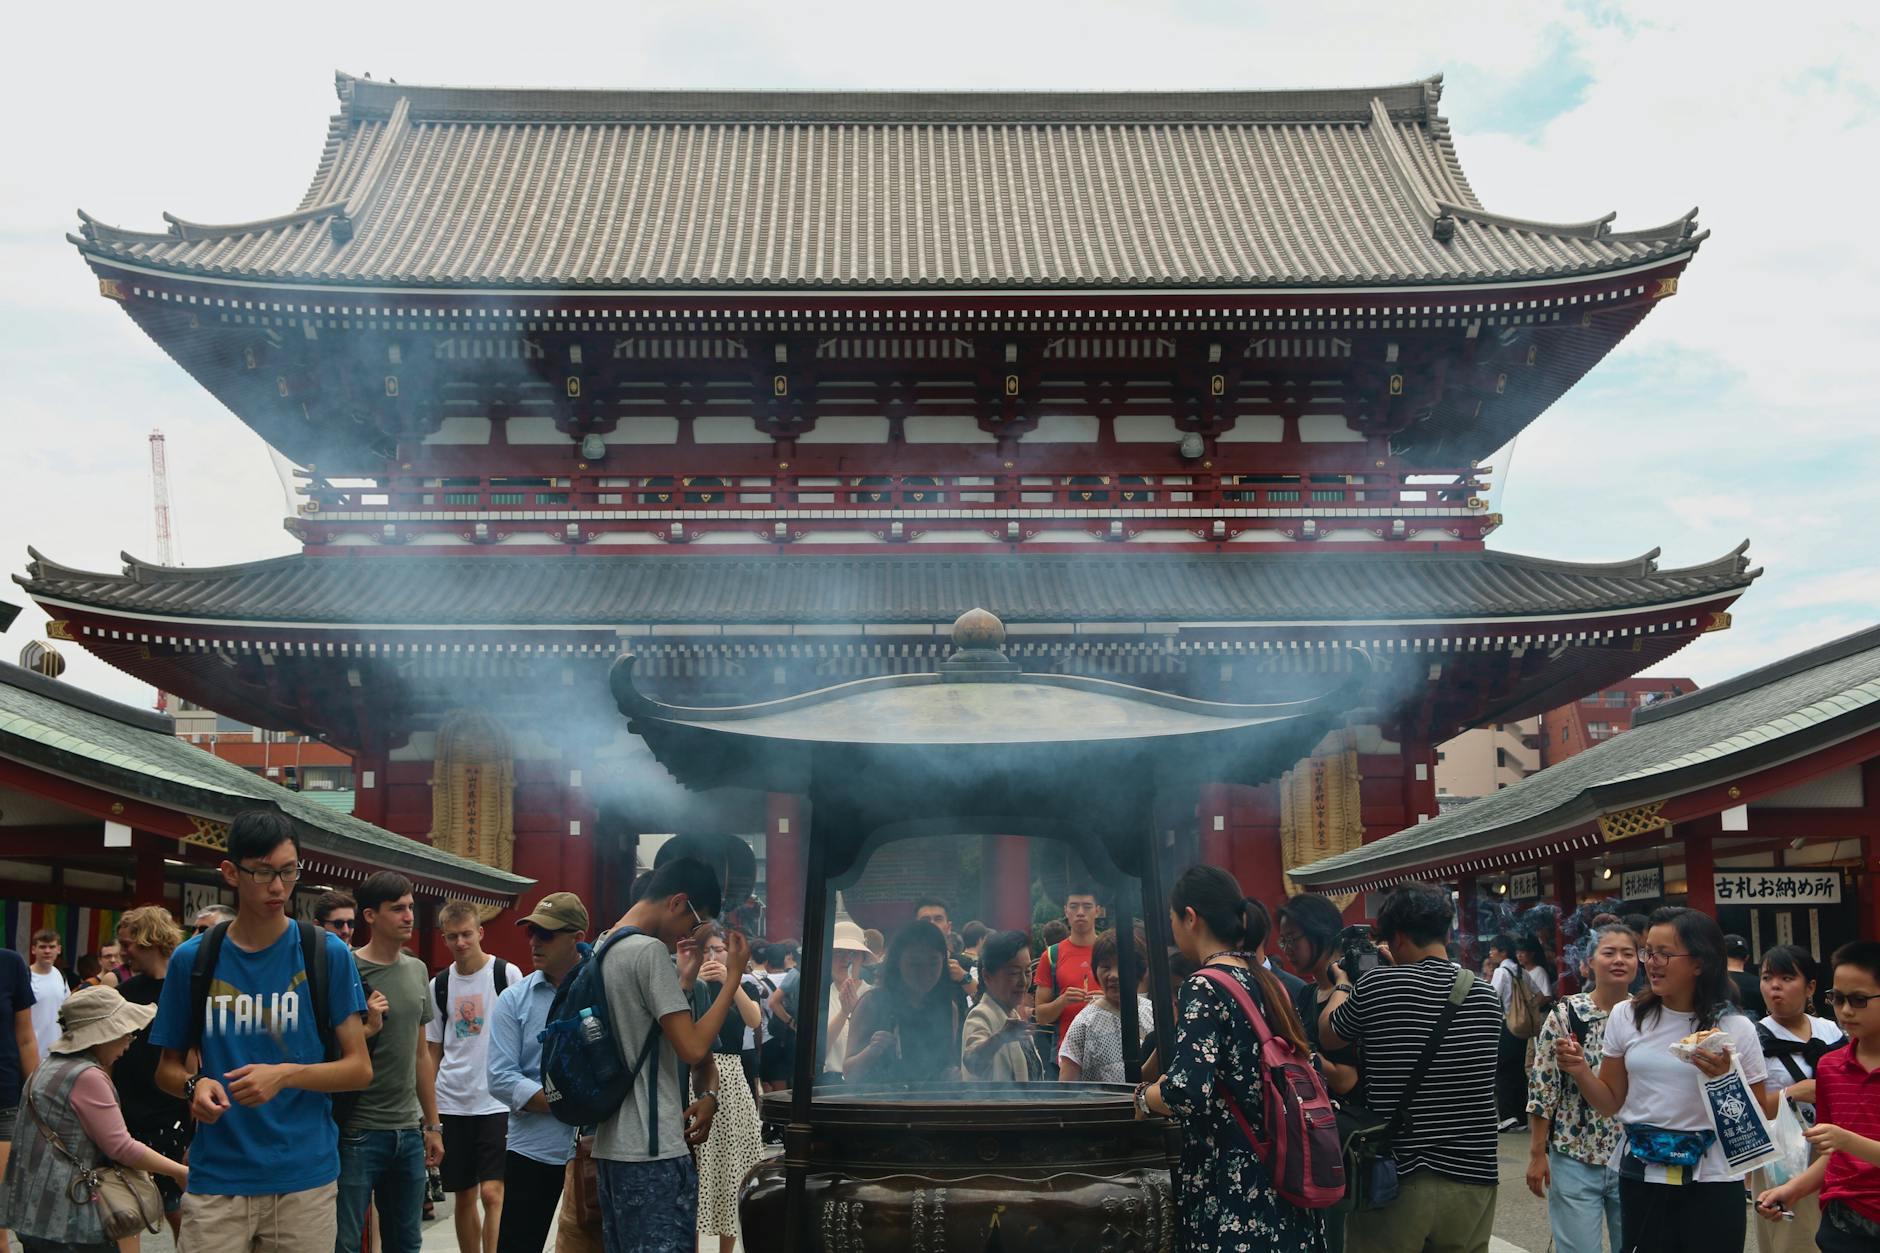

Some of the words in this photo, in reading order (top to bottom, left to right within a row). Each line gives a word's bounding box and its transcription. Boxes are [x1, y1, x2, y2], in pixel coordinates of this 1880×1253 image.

[1715, 876, 1834, 899] 古札お納め所
[205, 991, 299, 1037] ITALIA
[1670, 1151, 1689, 1159] SPORT
